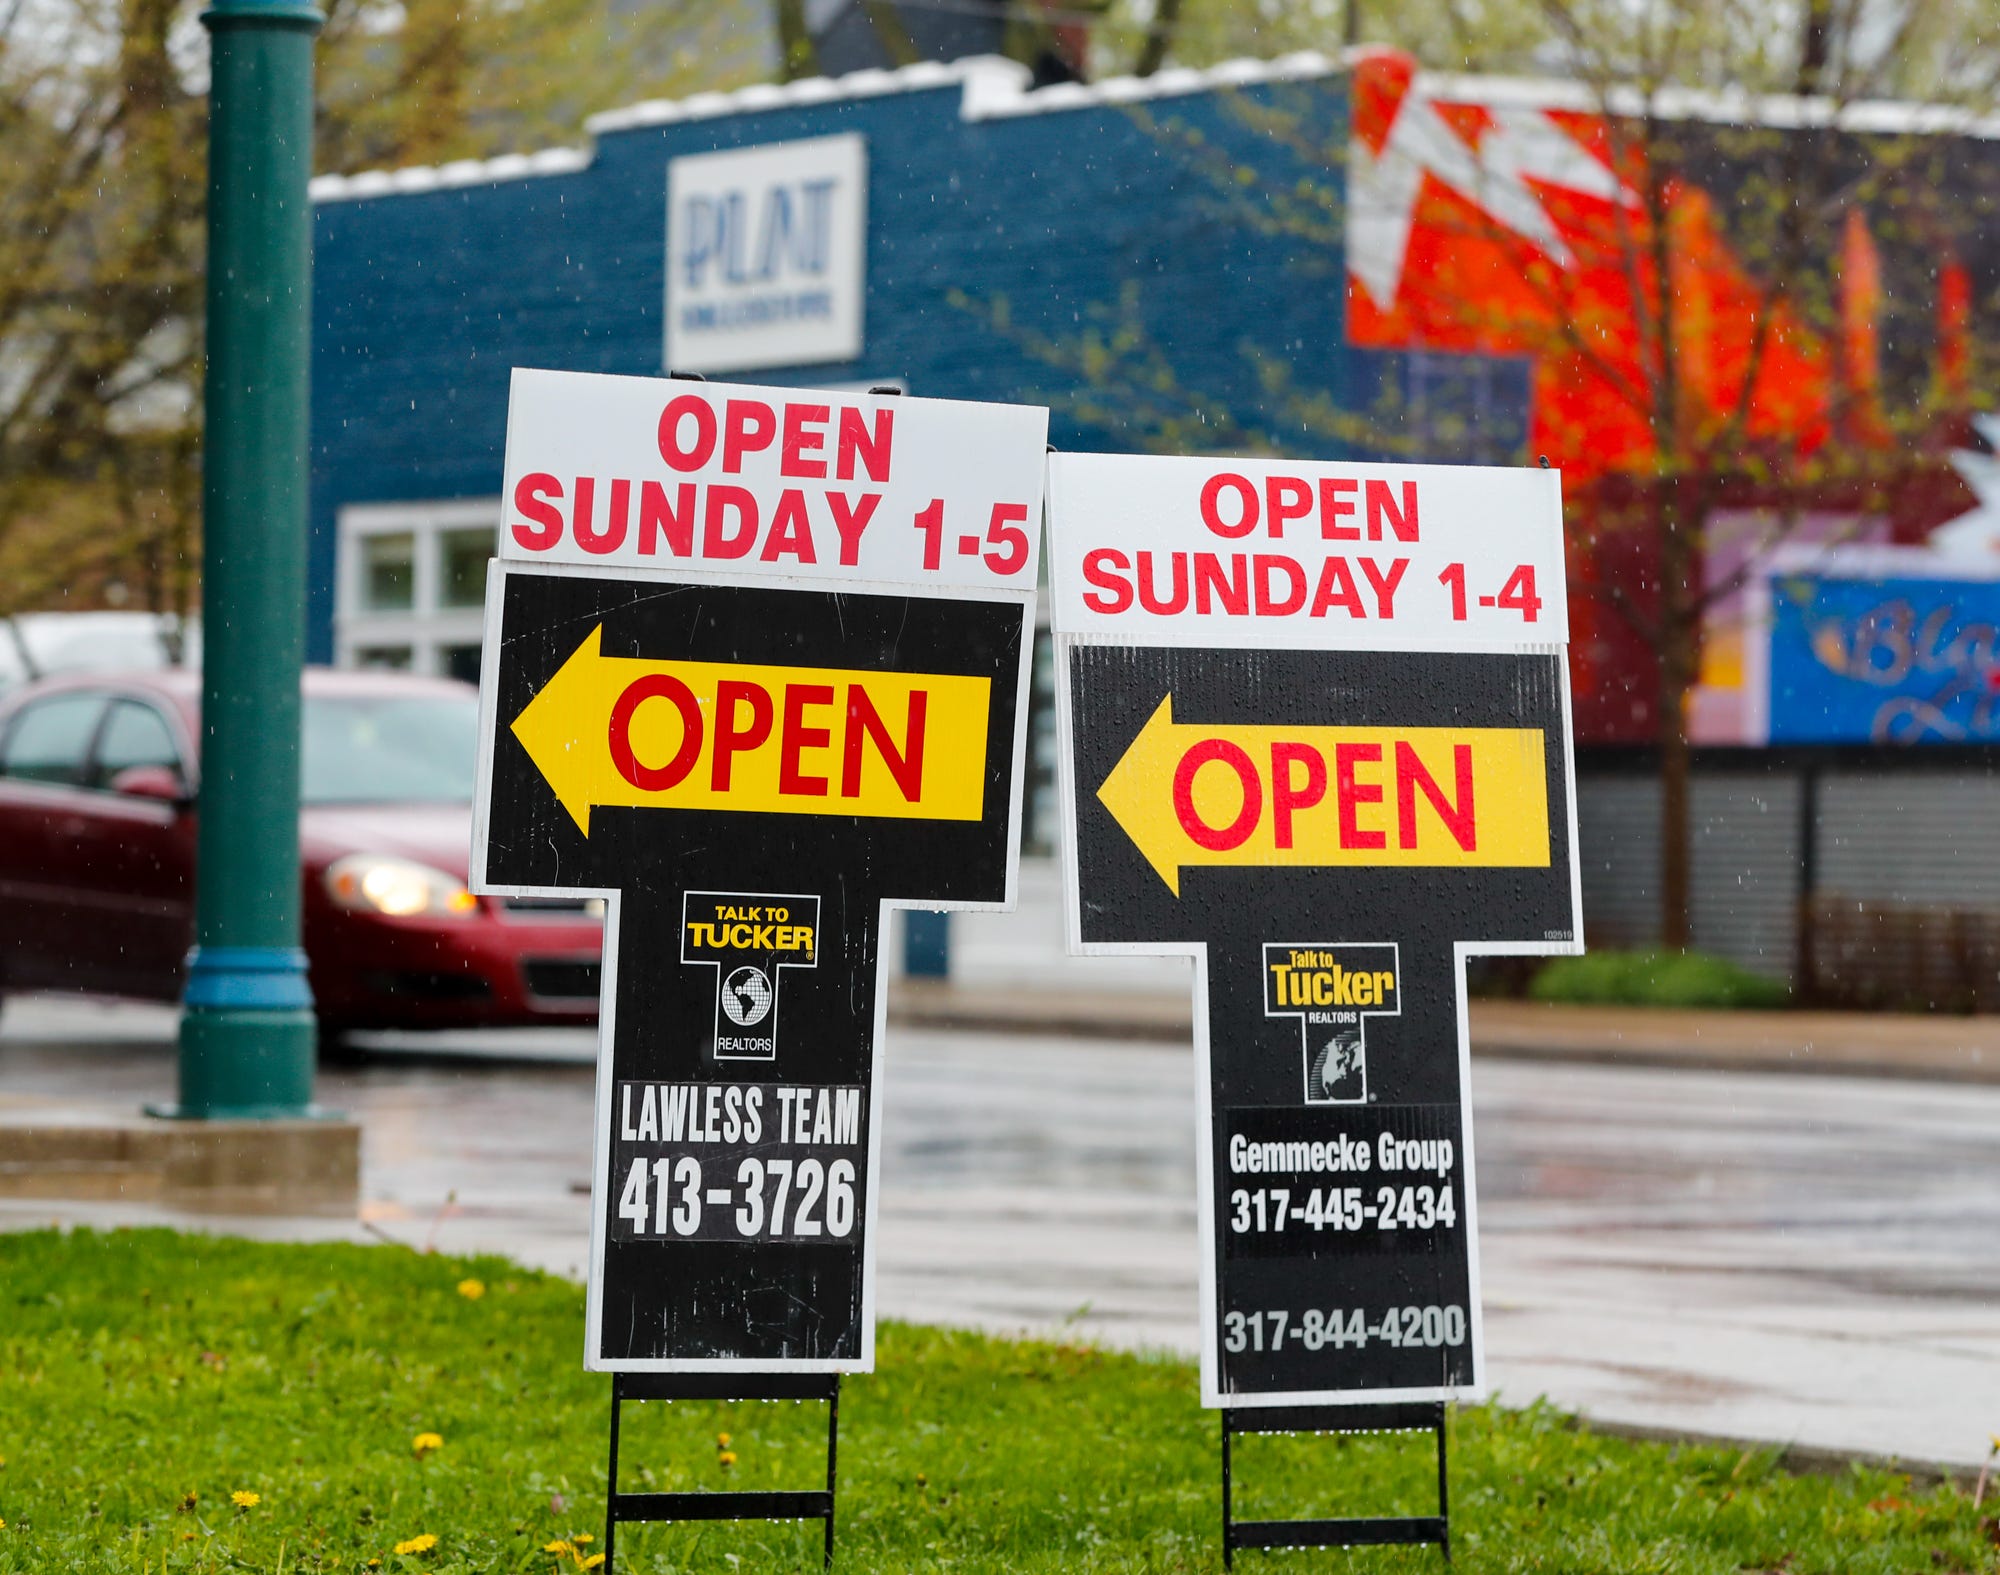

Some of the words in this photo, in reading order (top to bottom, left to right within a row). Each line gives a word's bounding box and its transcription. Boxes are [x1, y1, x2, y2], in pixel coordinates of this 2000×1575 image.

[684, 177, 841, 290] PLAT
[657, 394, 894, 482] OPEN
[511, 472, 882, 566] SUNDAY
[913, 498, 1030, 576] 1-5
[1199, 473, 1420, 543] OPEN
[1081, 548, 1411, 619] SUNDAY
[1437, 562, 1543, 623] 1-4
[608, 673, 928, 803] OPEN
[1172, 738, 1477, 853] OPEN
[687, 922, 814, 951] TUCKER
[715, 905, 761, 922] TALK
[767, 907, 789, 923] TO
[1544, 929, 1573, 940] 102519
[1289, 950, 1318, 969] Talk
[1319, 952, 1334, 969] to
[1270, 963, 1394, 1006] Tucker
[1308, 1011, 1357, 1025] REALTORS
[717, 1036, 772, 1052] REALTORS
[620, 1084, 763, 1144] LAWLESS
[776, 1088, 860, 1145] TEAM
[1229, 1133, 1371, 1174] Gemmecke
[1377, 1131, 1454, 1178] Group
[618, 1157, 856, 1238] 413-3726
[1230, 1186, 1456, 1233] 317-445-2434
[1224, 1305, 1466, 1352] 317-844-4200
